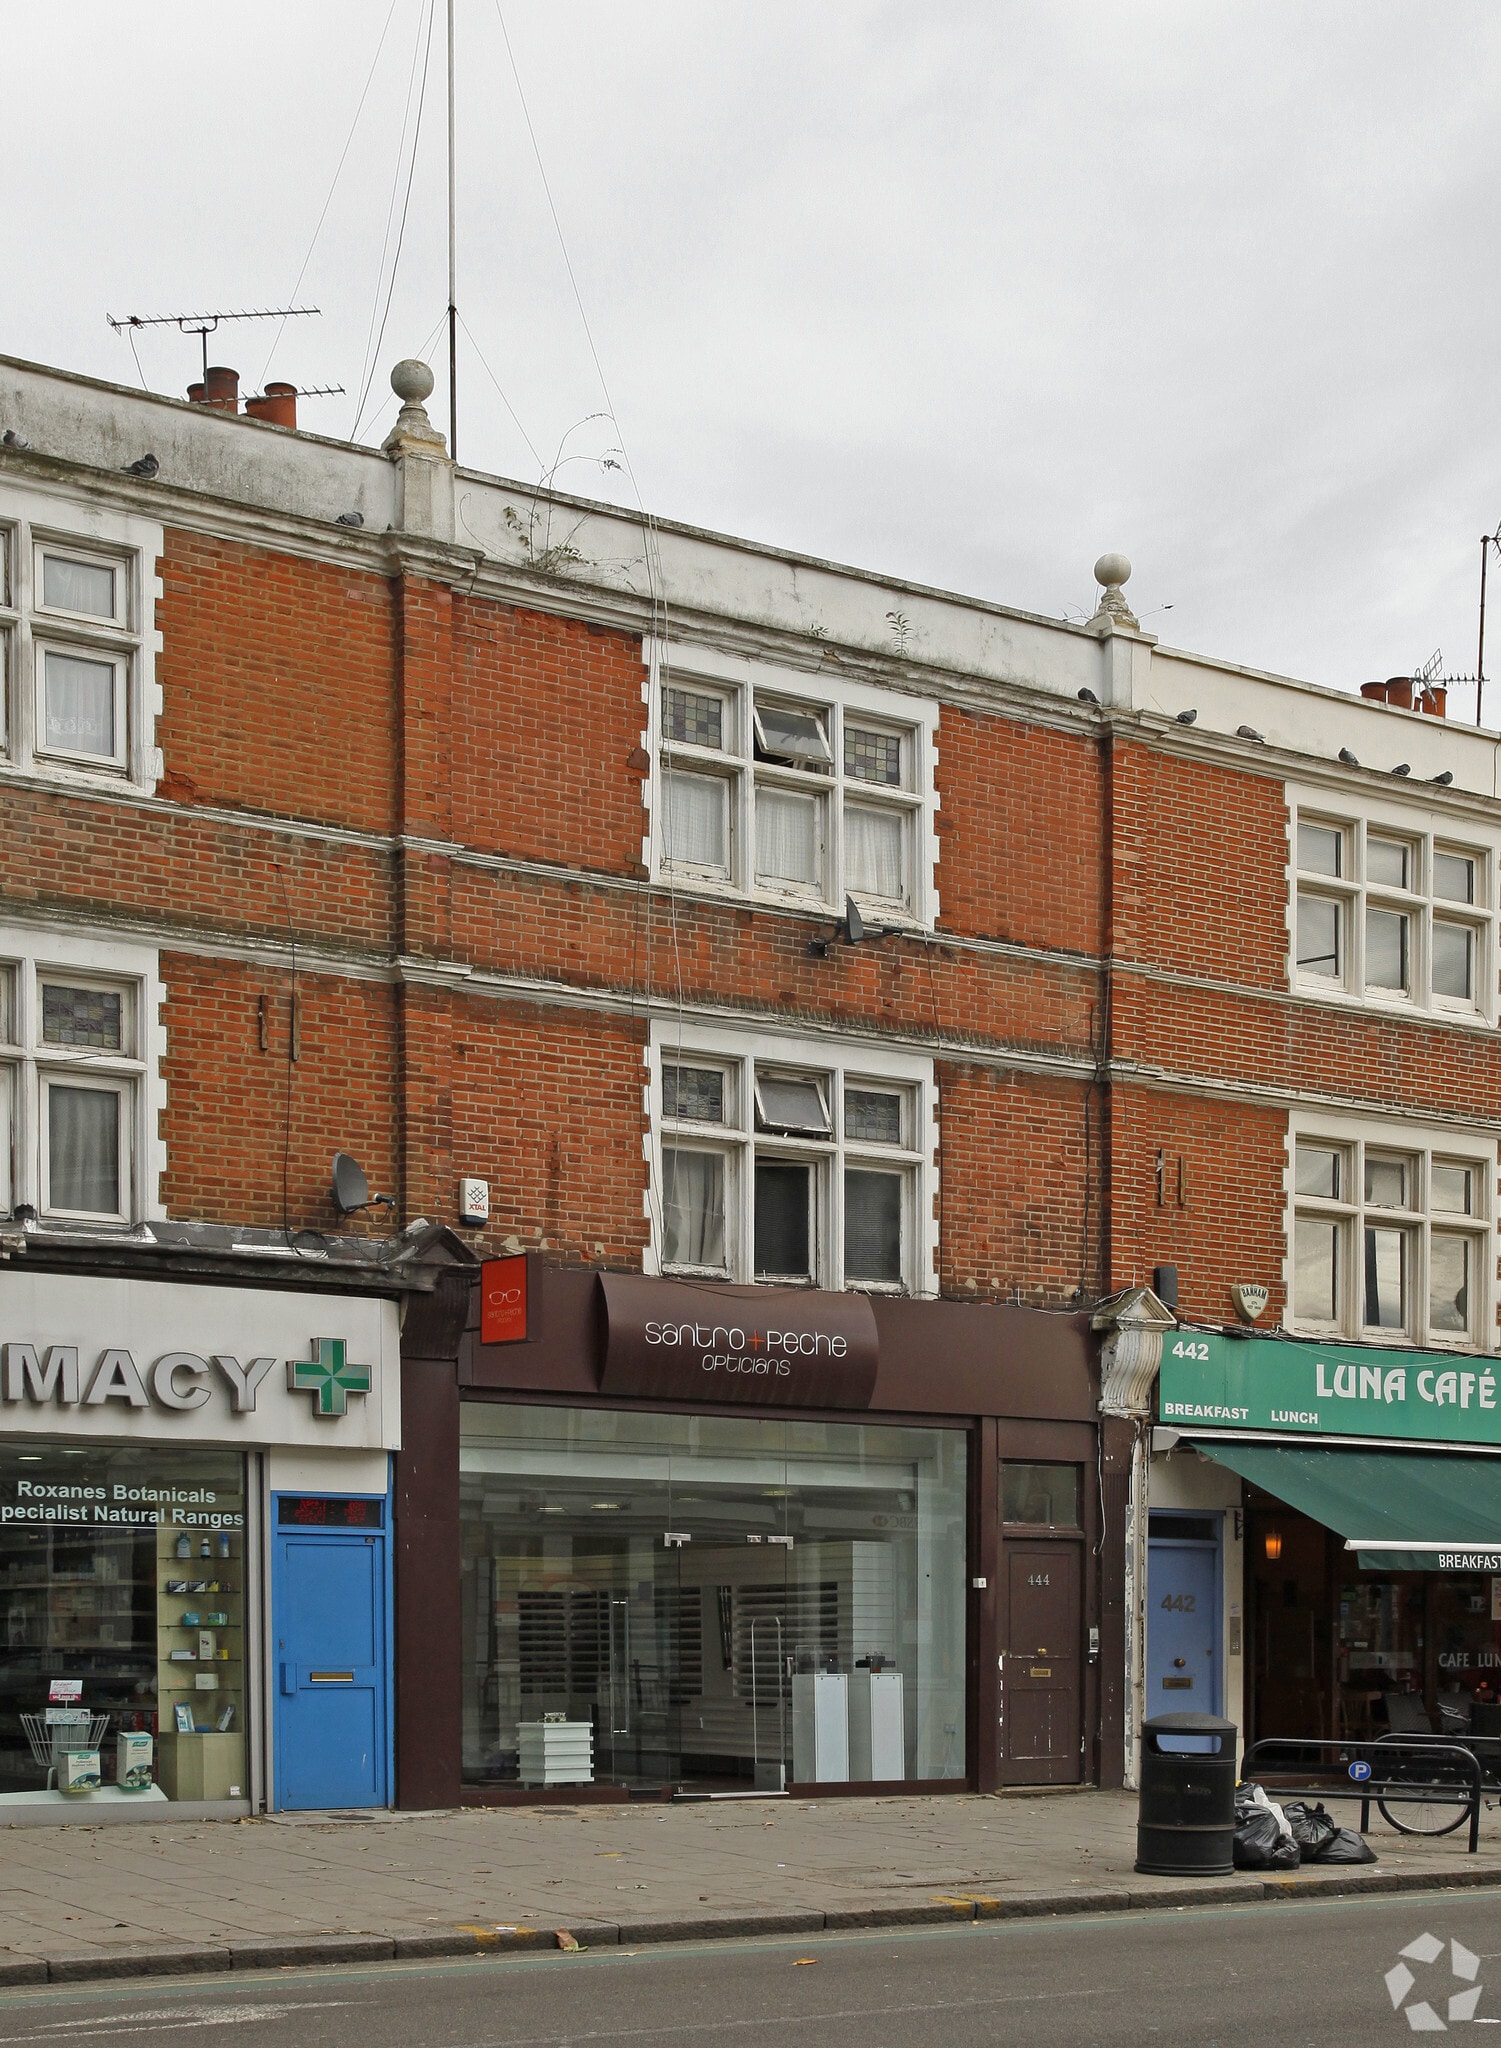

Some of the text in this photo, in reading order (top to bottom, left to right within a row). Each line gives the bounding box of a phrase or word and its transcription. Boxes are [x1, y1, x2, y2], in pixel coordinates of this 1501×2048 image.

[468, 1203, 487, 1212] XTAL
[1241, 1287, 1268, 1300] BANHAM
[1172, 1341, 1209, 1361] 442
[2, 1342, 277, 1413] MACY
[1316, 1363, 1497, 1409] LUNA CAFÉ
[1164, 1402, 1318, 1424] BREAKFAST LUNCH
[17, 1481, 216, 1504] Roxanes Botanicals
[94, 1505, 165, 1524] Natural
[172, 1508, 244, 1529] Ranges
[1027, 1575, 1050, 1586] 444
[1161, 1594, 1196, 1612] 442
[1438, 1653, 1470, 1668] CAFE
[1354, 1764, 1367, 1778] P
